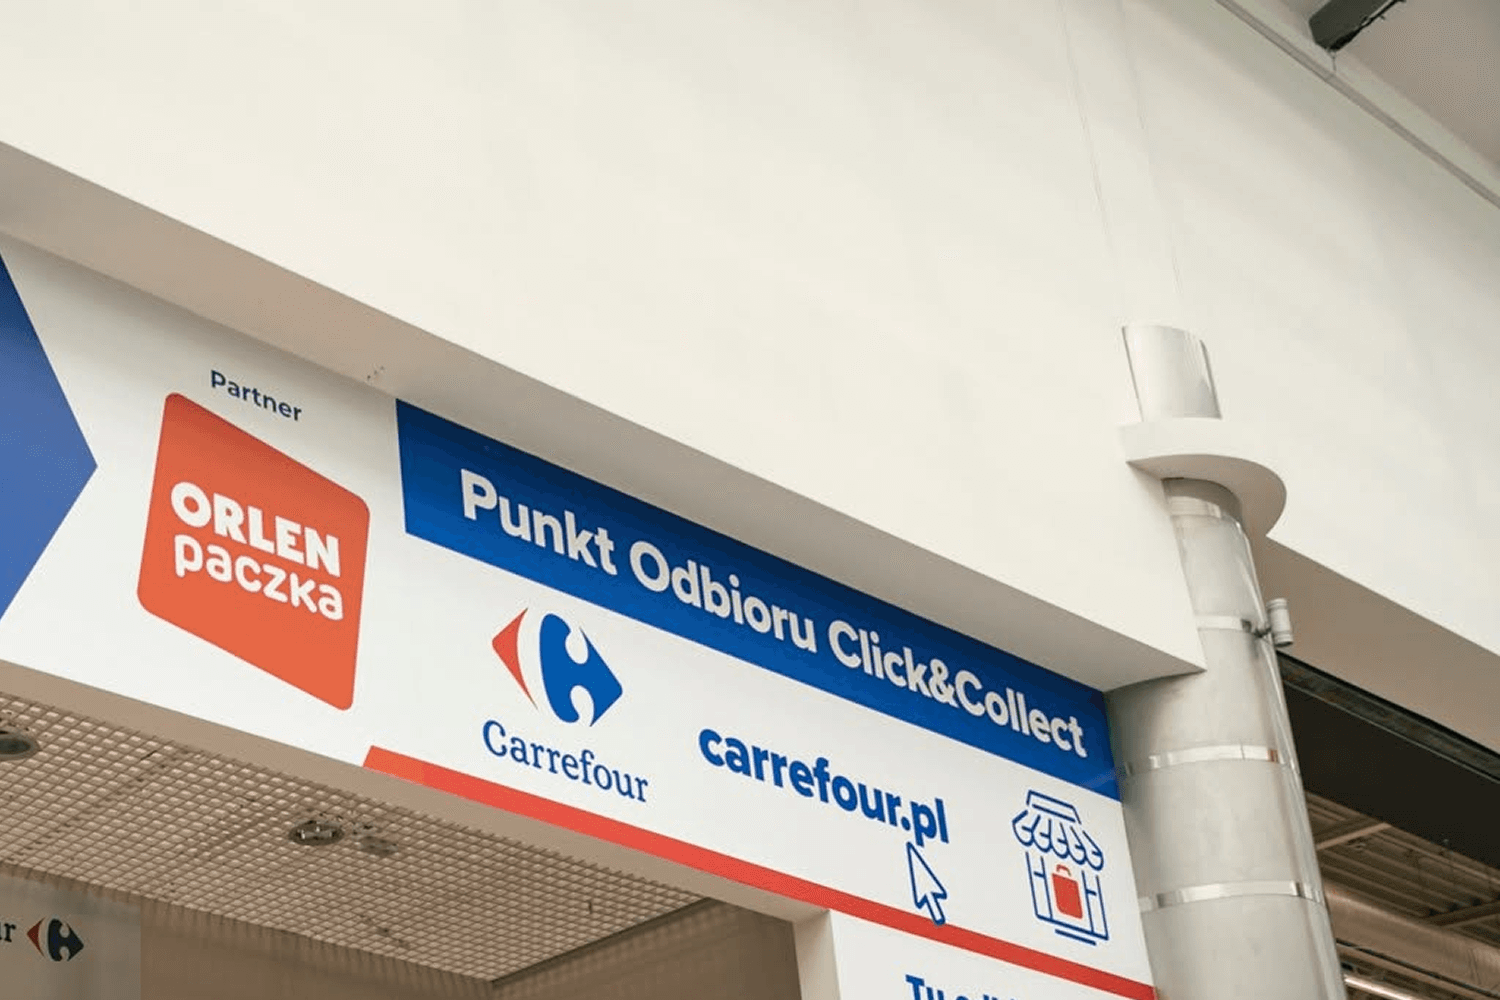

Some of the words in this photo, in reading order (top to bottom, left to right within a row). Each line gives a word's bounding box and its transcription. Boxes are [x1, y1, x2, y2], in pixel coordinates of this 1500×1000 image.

[210, 370, 302, 421] Partner
[171, 482, 340, 578] ORLEN
[174, 534, 343, 621] paczka
[461, 468, 617, 576] Punkt
[629, 540, 816, 653] Odbioru
[829, 620, 1088, 758] Click&Collect
[483, 719, 649, 803] Carrefour
[699, 727, 949, 847] carrefour.pl
